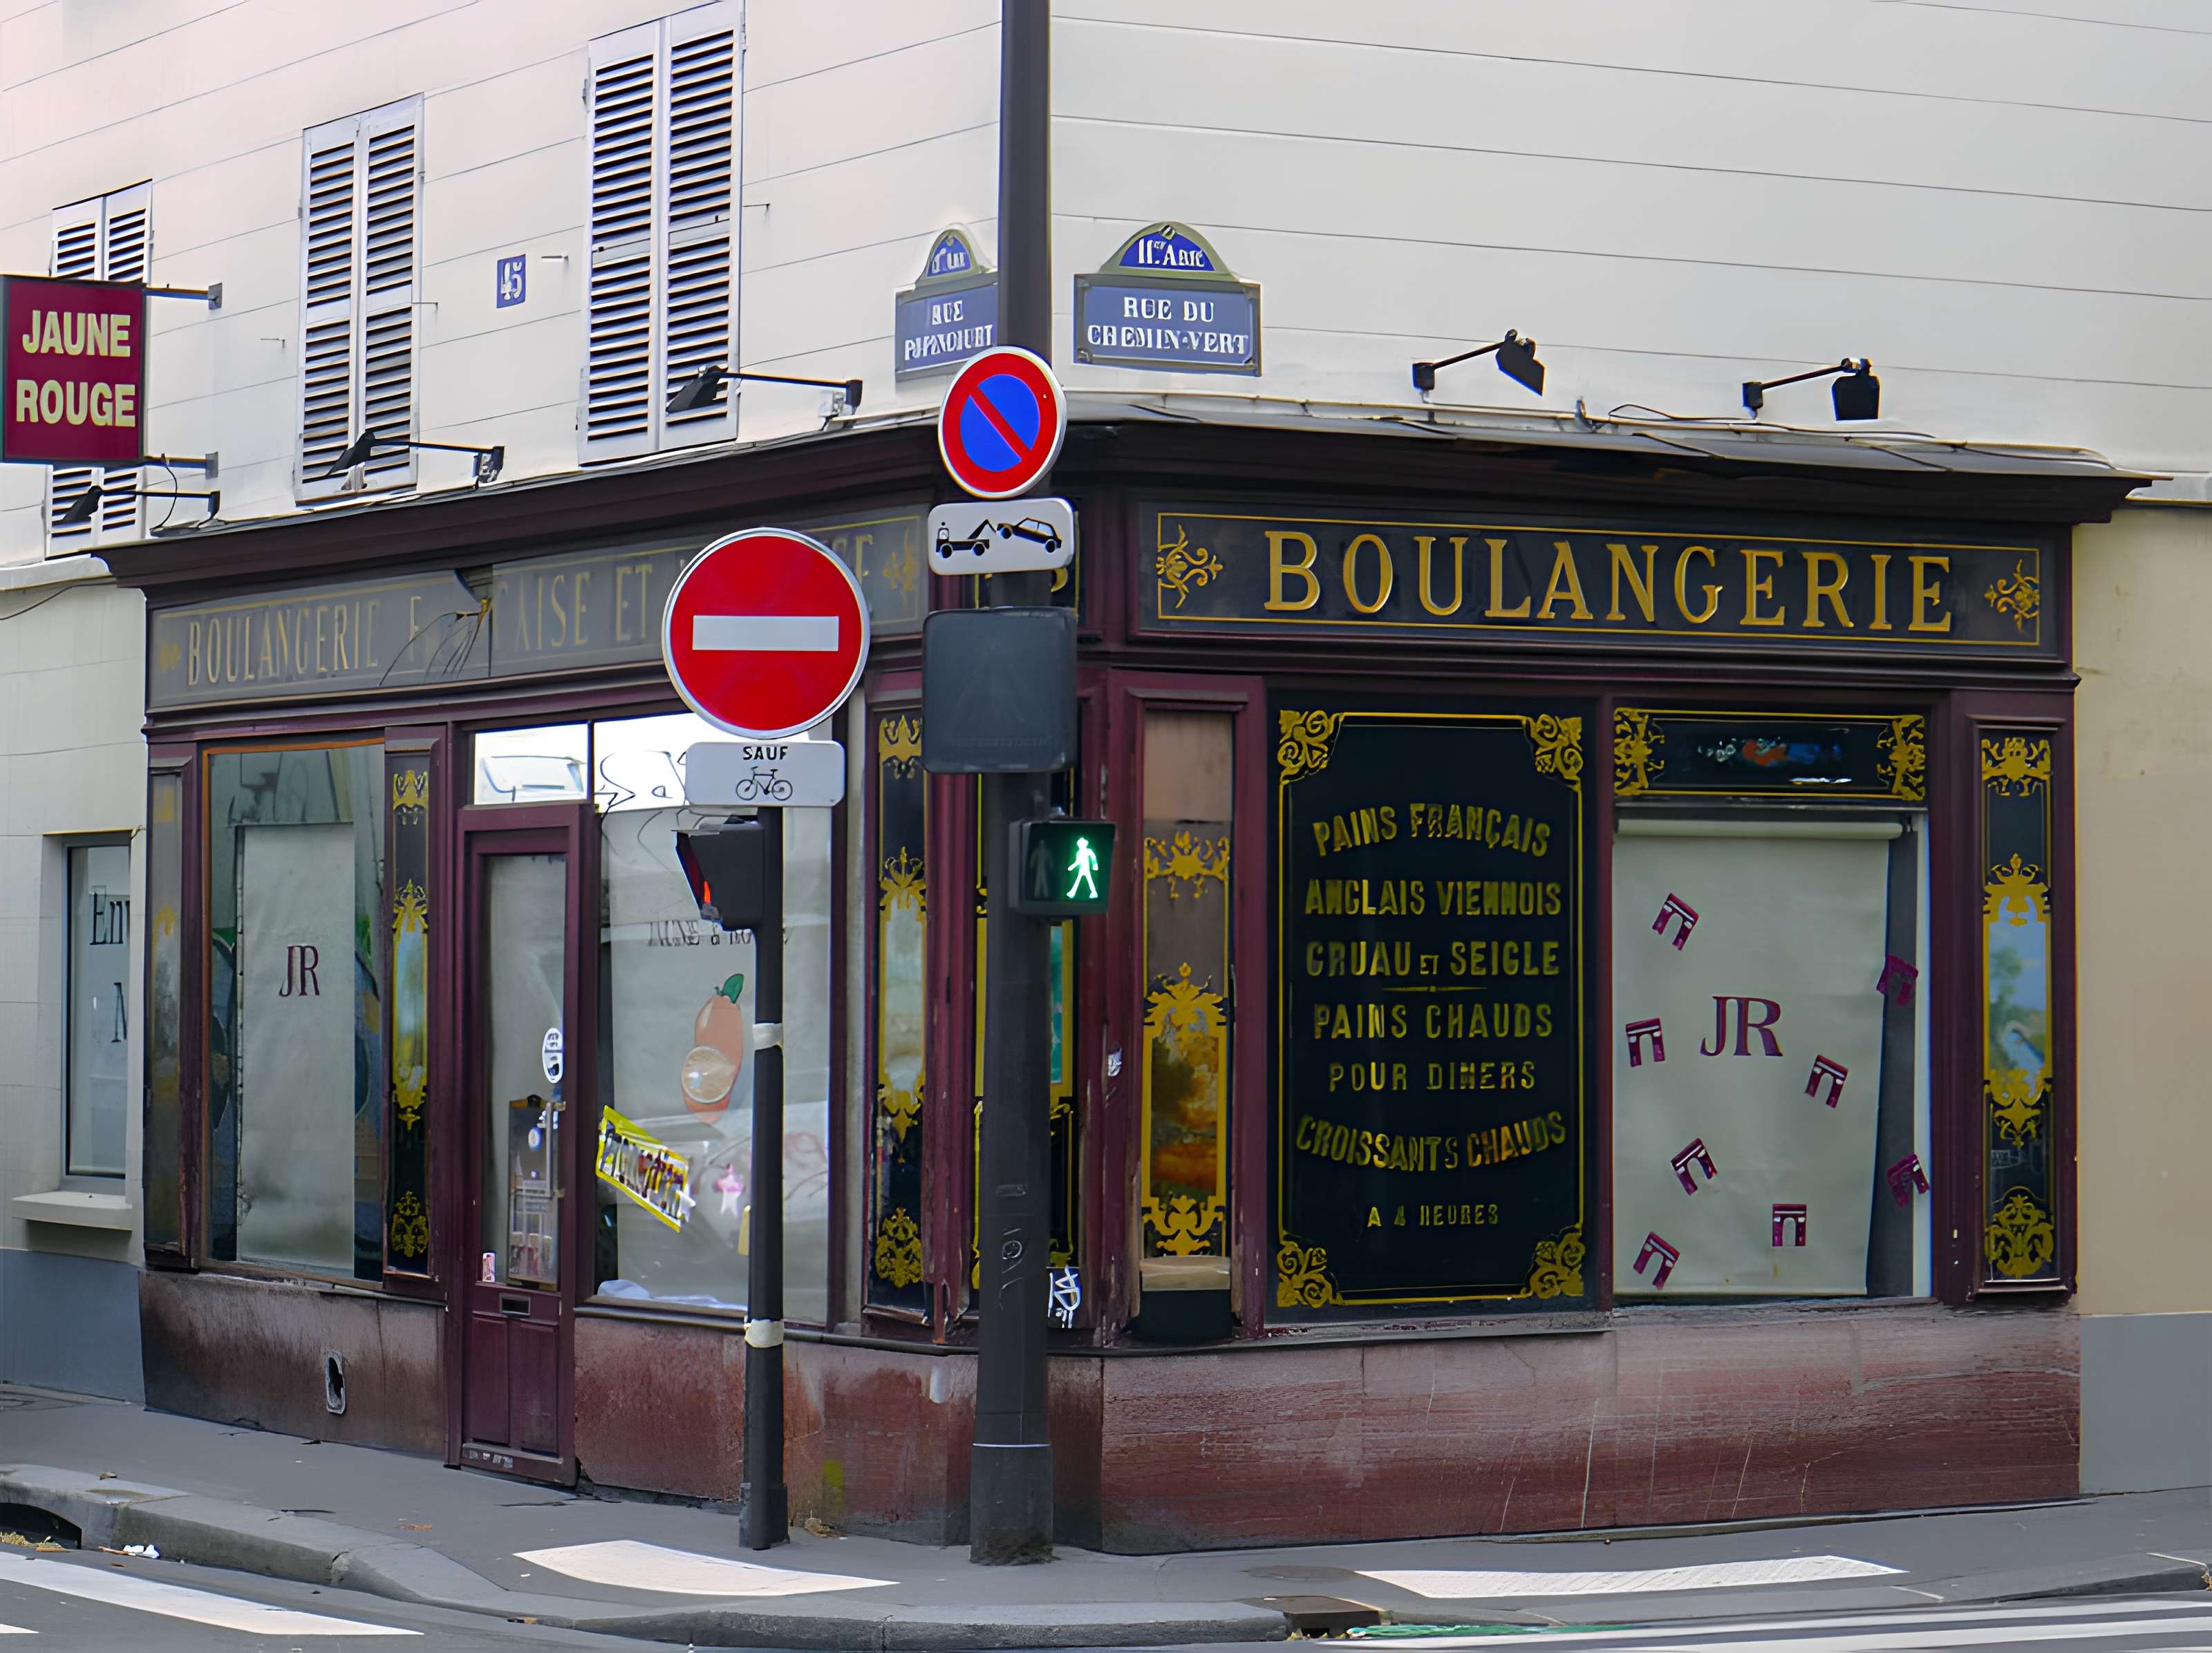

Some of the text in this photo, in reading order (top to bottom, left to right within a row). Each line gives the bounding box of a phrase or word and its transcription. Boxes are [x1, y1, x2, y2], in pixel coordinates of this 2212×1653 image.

[500, 261, 523, 300] 45
[1123, 296, 1215, 323] RUE DU
[21, 309, 131, 357] JAUNE
[1087, 324, 1249, 355] CHEMIN-VERT
[15, 379, 137, 427] ROUGE
[1263, 529, 1952, 633] BOULANGERIE
[187, 598, 381, 686] BOULANGERIE
[615, 563, 653, 643] ET
[742, 745, 789, 761] SAUF
[1312, 802, 1550, 857] PAINS FRANÇAIS
[1304, 878, 1562, 916] ANGLAIS VIENNOIS
[279, 944, 321, 997] JR
[1305, 941, 1560, 976] GRUAU ET SEIGLE
[1313, 1003, 1553, 1039] PAINS CHAUDS
[1700, 995, 1784, 1057] JR
[1329, 1061, 1408, 1092] POUR
[1295, 1111, 1566, 1172] CROISSANTS CHAUDS
[1367, 1204, 1499, 1228] A 4 HEURES
